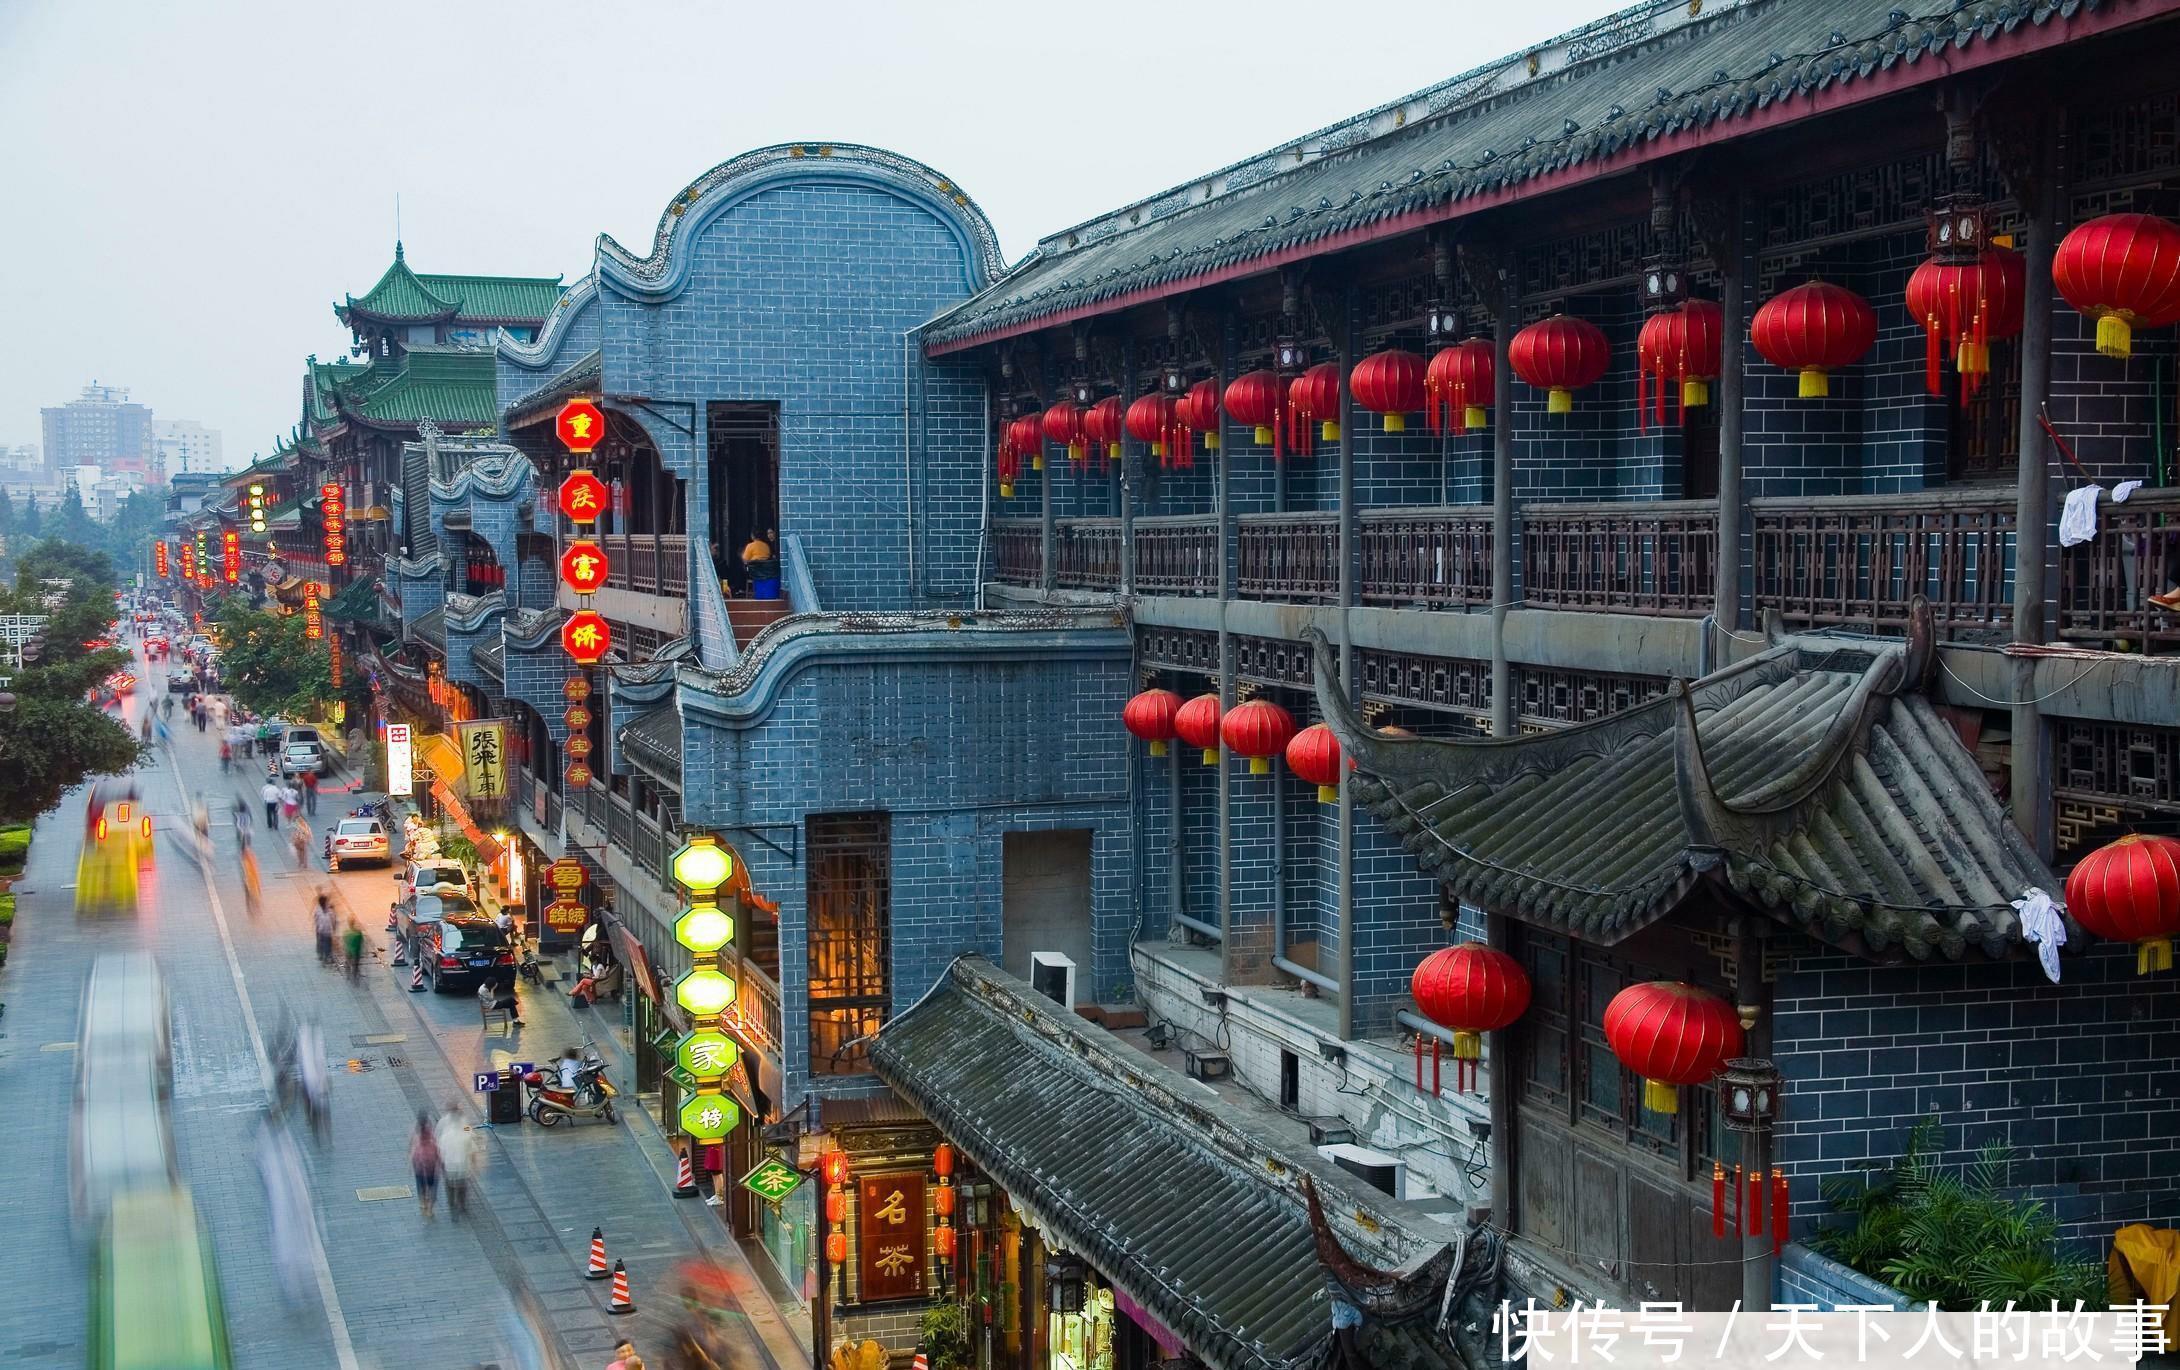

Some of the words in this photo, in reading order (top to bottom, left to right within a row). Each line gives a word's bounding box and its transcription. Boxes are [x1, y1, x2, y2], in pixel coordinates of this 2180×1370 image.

[565, 412, 603, 650] 重庆富侨
[477, 1075, 488, 1091] P
[757, 1168, 794, 1192] 茶
[874, 1189, 914, 1277] 名茶
